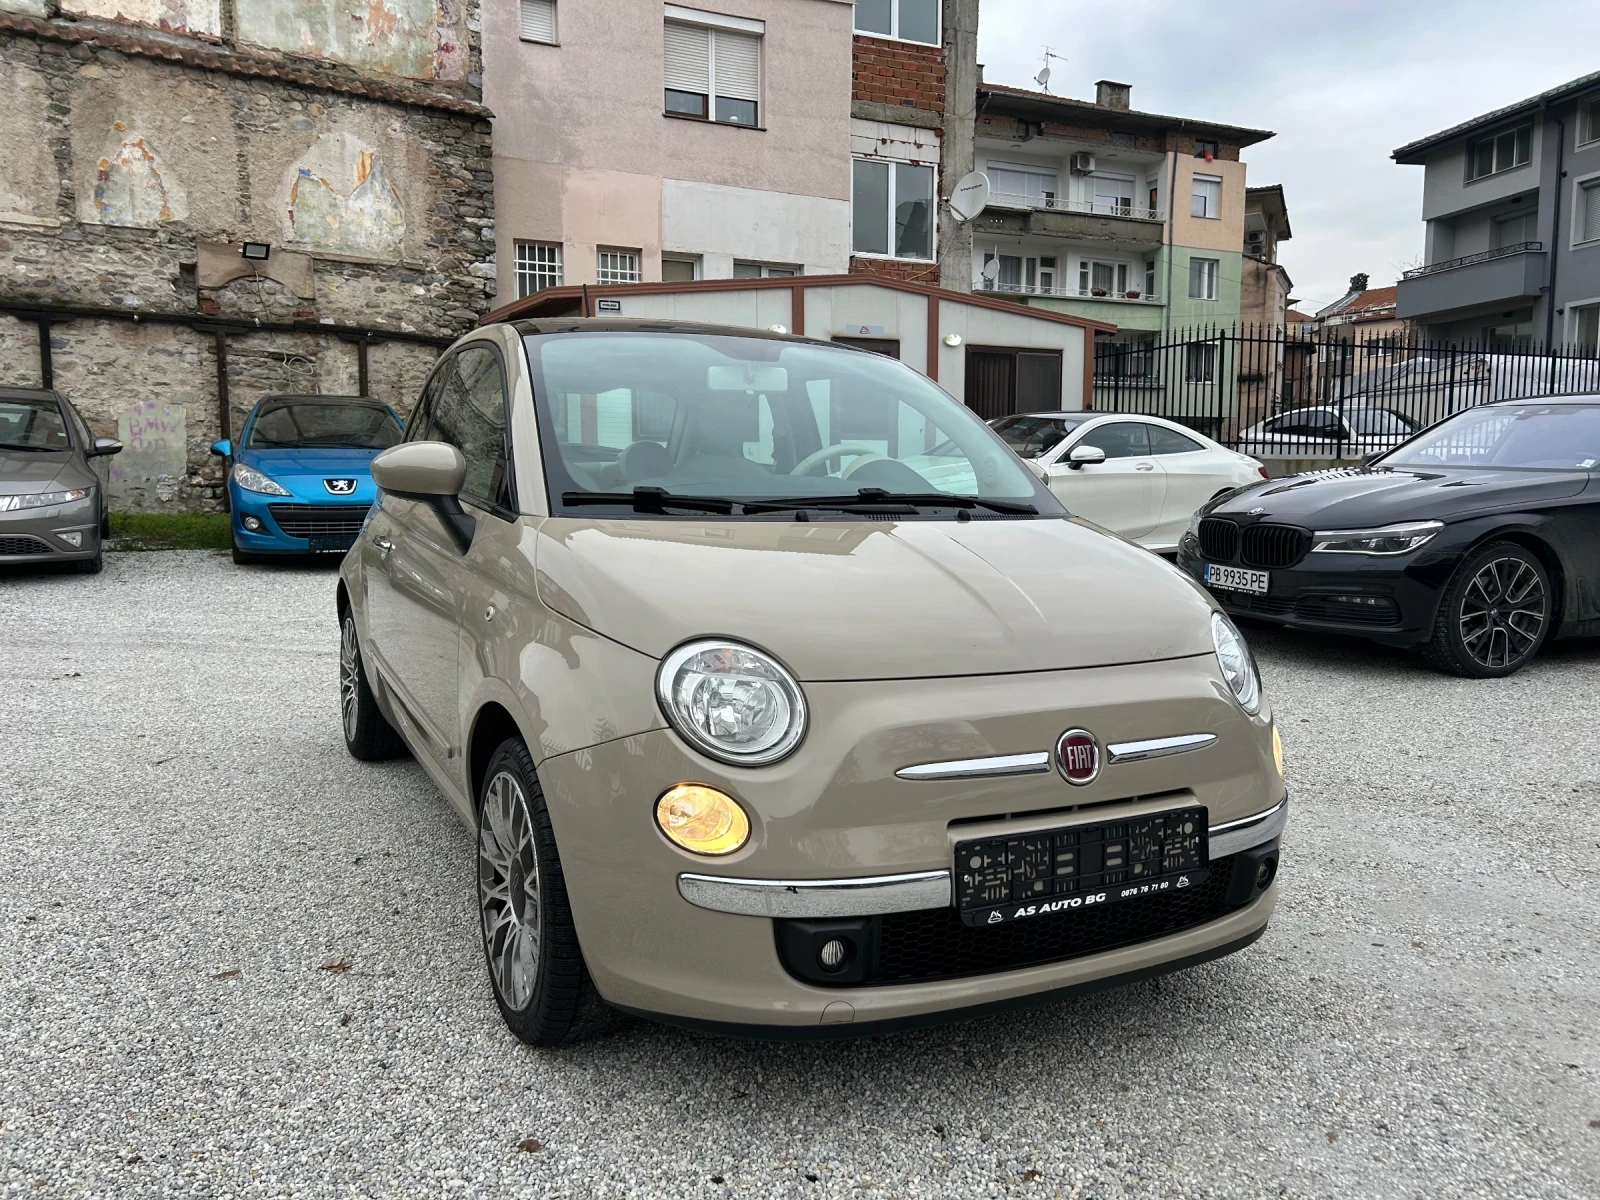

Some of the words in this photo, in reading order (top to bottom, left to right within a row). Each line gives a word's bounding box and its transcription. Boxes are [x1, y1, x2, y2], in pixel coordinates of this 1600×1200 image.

[1209, 566, 1221, 582] PB
[1223, 569, 1248, 586] 9935
[1250, 573, 1266, 590] PE
[1066, 745, 1092, 770] FIAT
[1140, 885, 1149, 893] 76
[1151, 883, 1159, 891] 71
[1160, 881, 1169, 889] 80
[1014, 906, 1036, 918] AS
[1039, 898, 1082, 914] AUTO
[1085, 893, 1107, 905] BG
